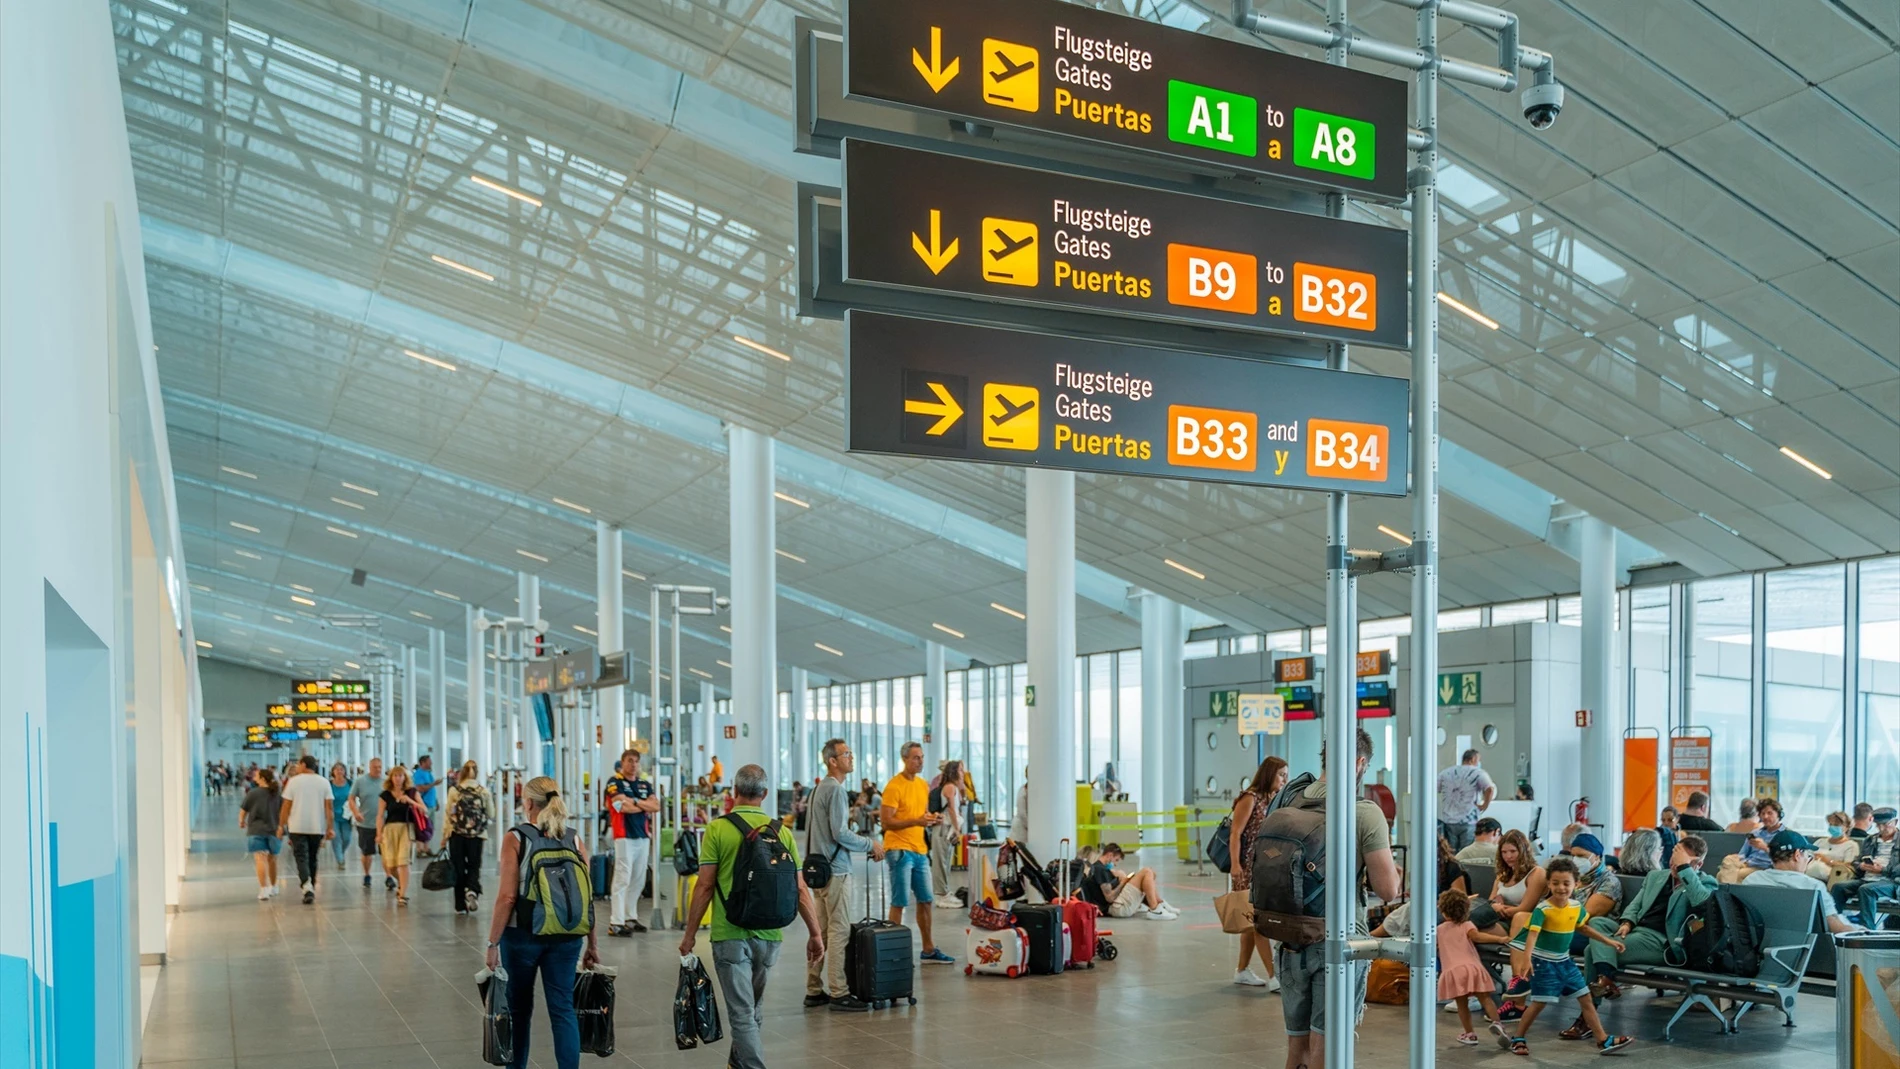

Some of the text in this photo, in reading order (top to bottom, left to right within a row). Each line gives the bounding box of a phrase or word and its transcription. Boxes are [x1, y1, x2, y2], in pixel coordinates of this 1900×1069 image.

[1055, 26, 1152, 72] Flugsteige
[1055, 57, 1112, 91] Gates
[1055, 87, 1152, 133] Puertas
[1188, 96, 1234, 143] A1
[1265, 104, 1285, 128] to
[1268, 139, 1282, 160] a
[1311, 123, 1357, 166] A8
[1054, 199, 1152, 239] Flugsteige
[1054, 230, 1112, 260] Gates
[1054, 260, 1152, 298] Puertas
[1189, 257, 1236, 301] B9
[1265, 261, 1285, 285] to
[1268, 295, 1282, 316] a
[1302, 275, 1368, 320] B32
[1055, 363, 1153, 401] Flugsteige
[1055, 393, 1112, 423] Gates
[1055, 424, 1152, 460] Puertas
[1176, 417, 1248, 461] B33
[1266, 420, 1299, 442] and
[1274, 449, 1290, 475] y
[1314, 430, 1381, 471] B34
[1284, 663, 1304, 678] B33
[1357, 656, 1377, 672] B34
